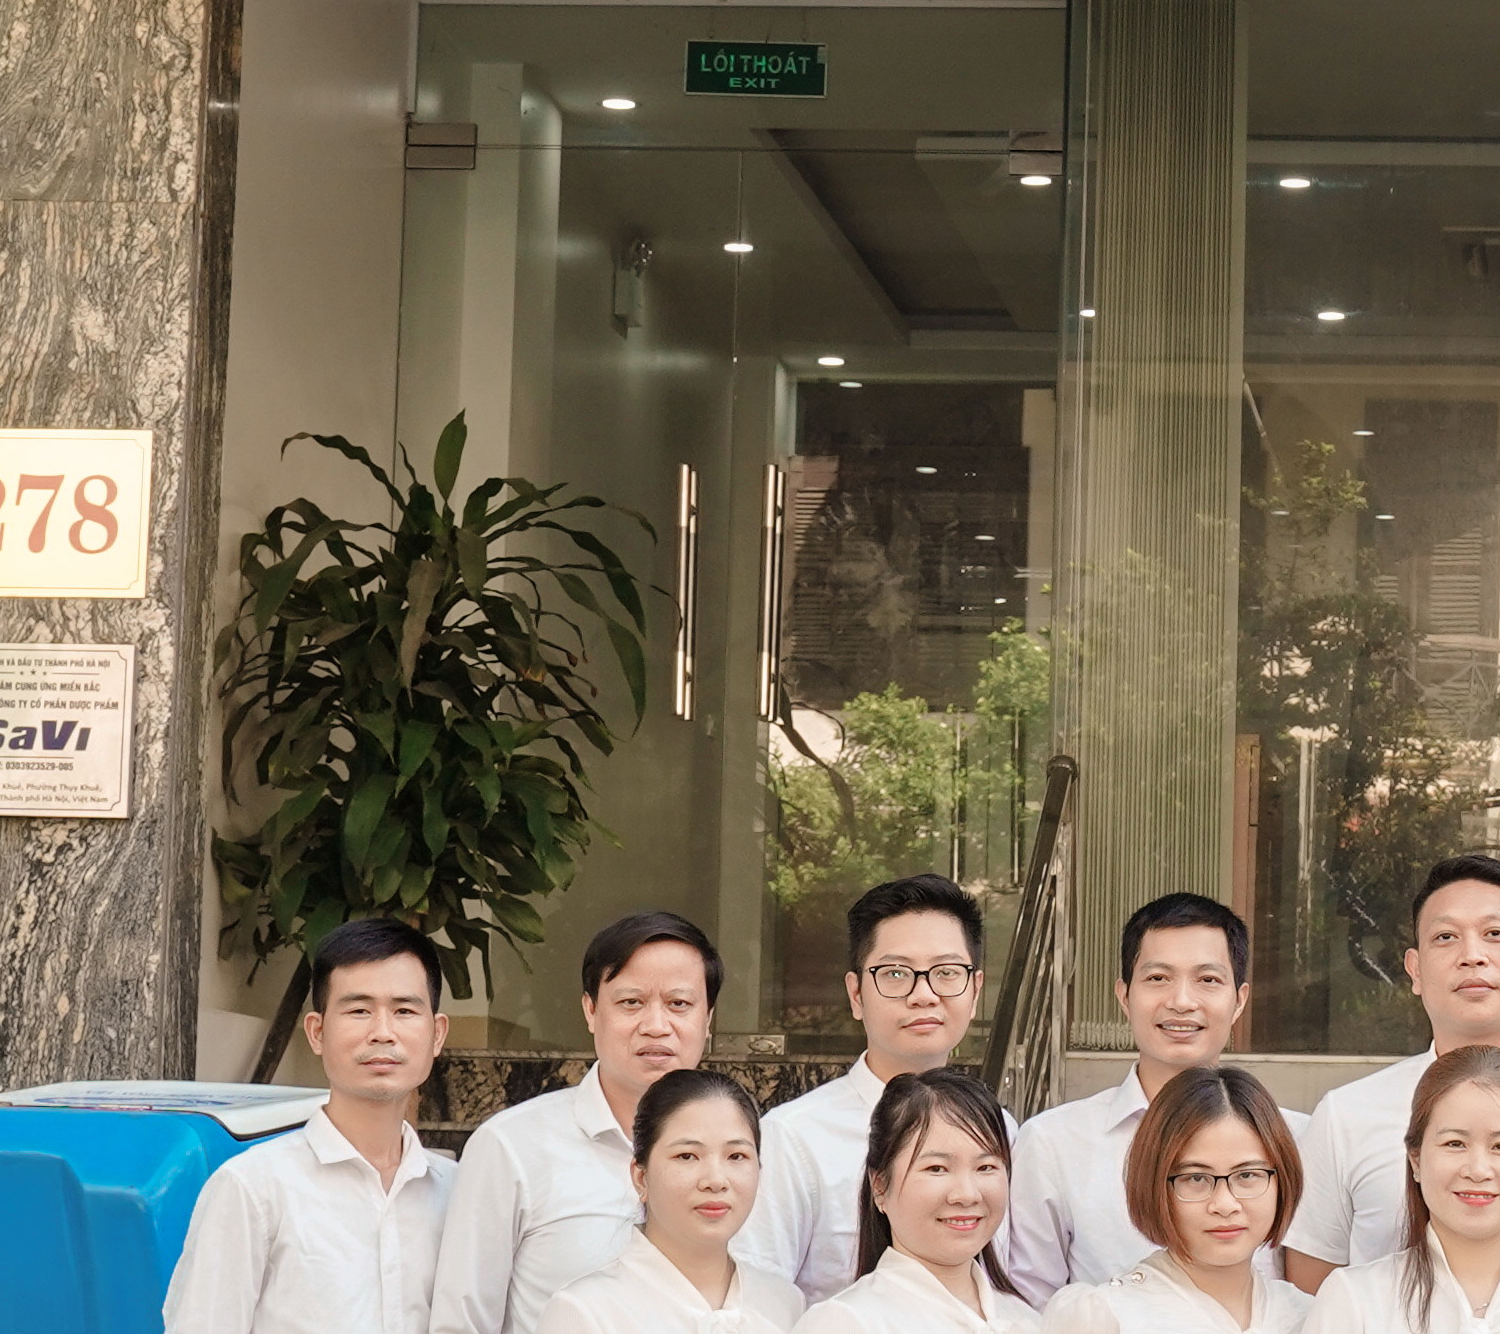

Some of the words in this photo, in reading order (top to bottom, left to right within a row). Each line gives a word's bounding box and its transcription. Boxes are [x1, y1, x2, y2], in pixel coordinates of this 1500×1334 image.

[700, 48, 735, 72] LỐI
[740, 51, 811, 75] THOÁT
[729, 77, 781, 89] EXIT
